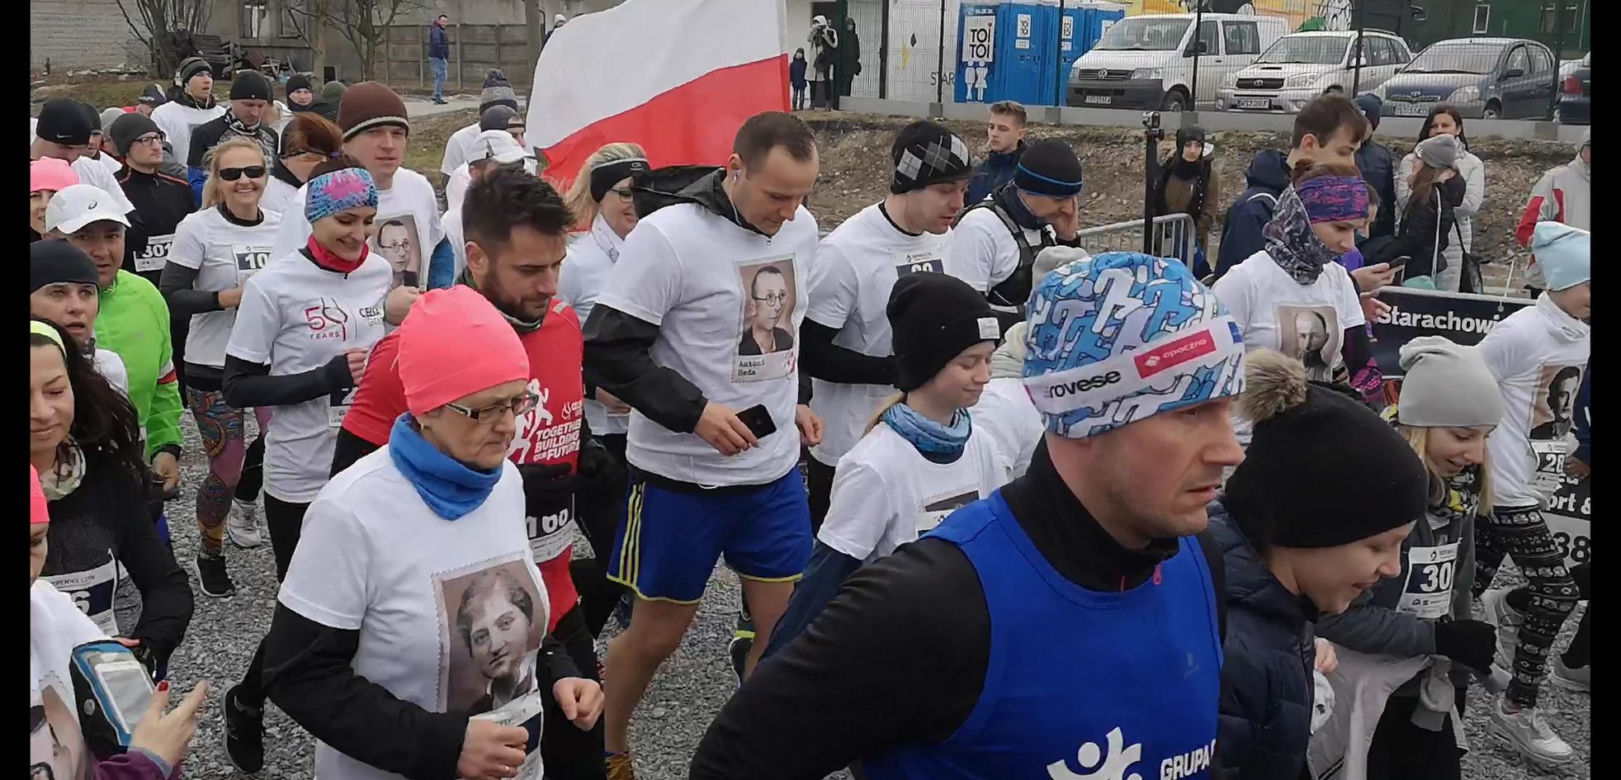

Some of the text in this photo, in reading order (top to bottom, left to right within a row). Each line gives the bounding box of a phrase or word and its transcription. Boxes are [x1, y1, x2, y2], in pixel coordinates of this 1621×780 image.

[970, 27, 991, 43] TOI
[969, 43, 991, 58] TOI
[931, 72, 955, 85] SAR
[309, 331, 340, 340] YEARS
[1160, 745, 1210, 780] GRUPA
